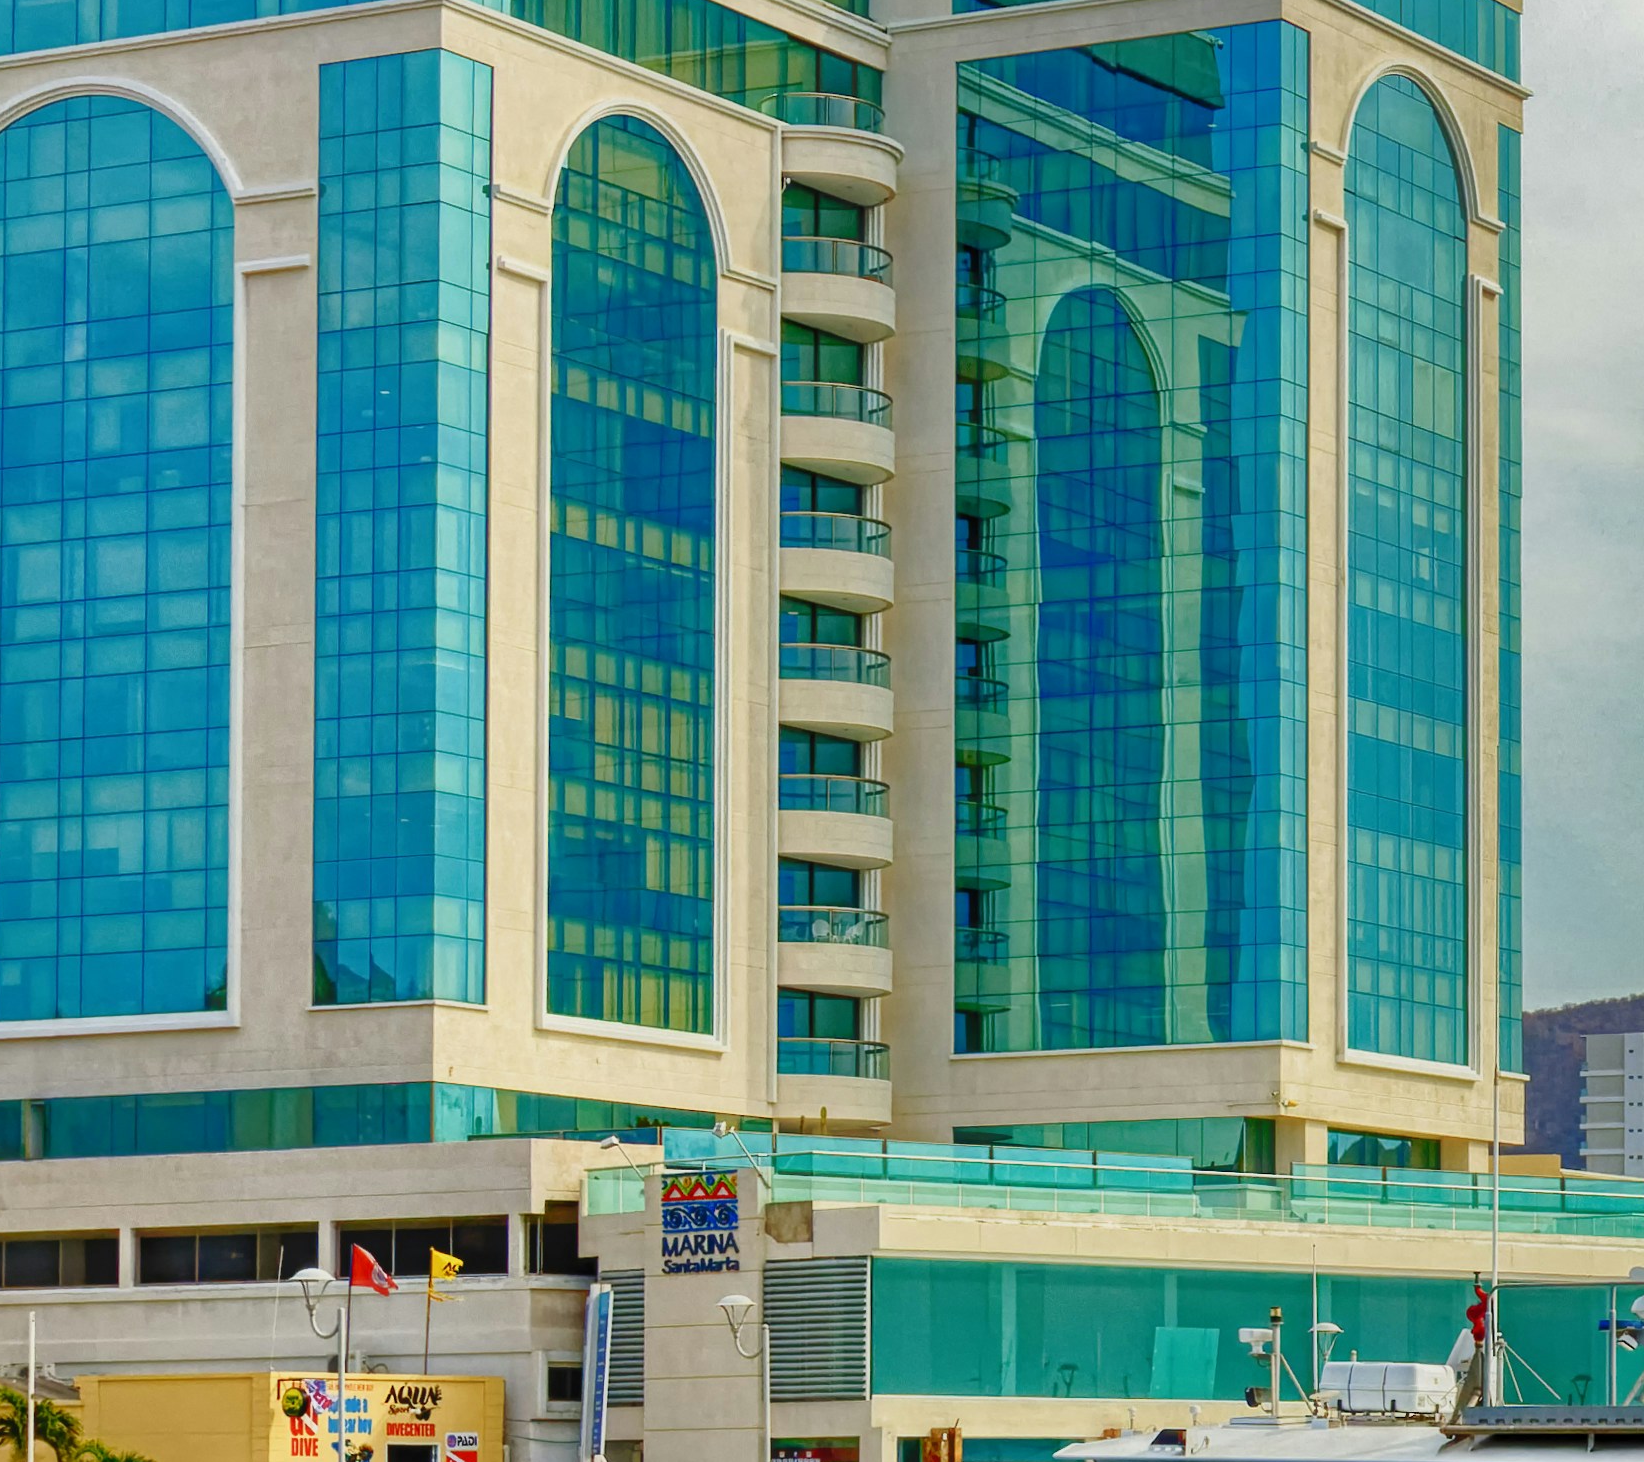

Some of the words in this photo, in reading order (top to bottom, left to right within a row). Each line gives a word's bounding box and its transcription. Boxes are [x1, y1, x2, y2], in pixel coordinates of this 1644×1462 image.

[661, 1232, 740, 1258] MARINA
[386, 1422, 436, 1437] DIVECENTER
[291, 1437, 319, 1457] DIVE
[456, 1435, 478, 1447] PADI
